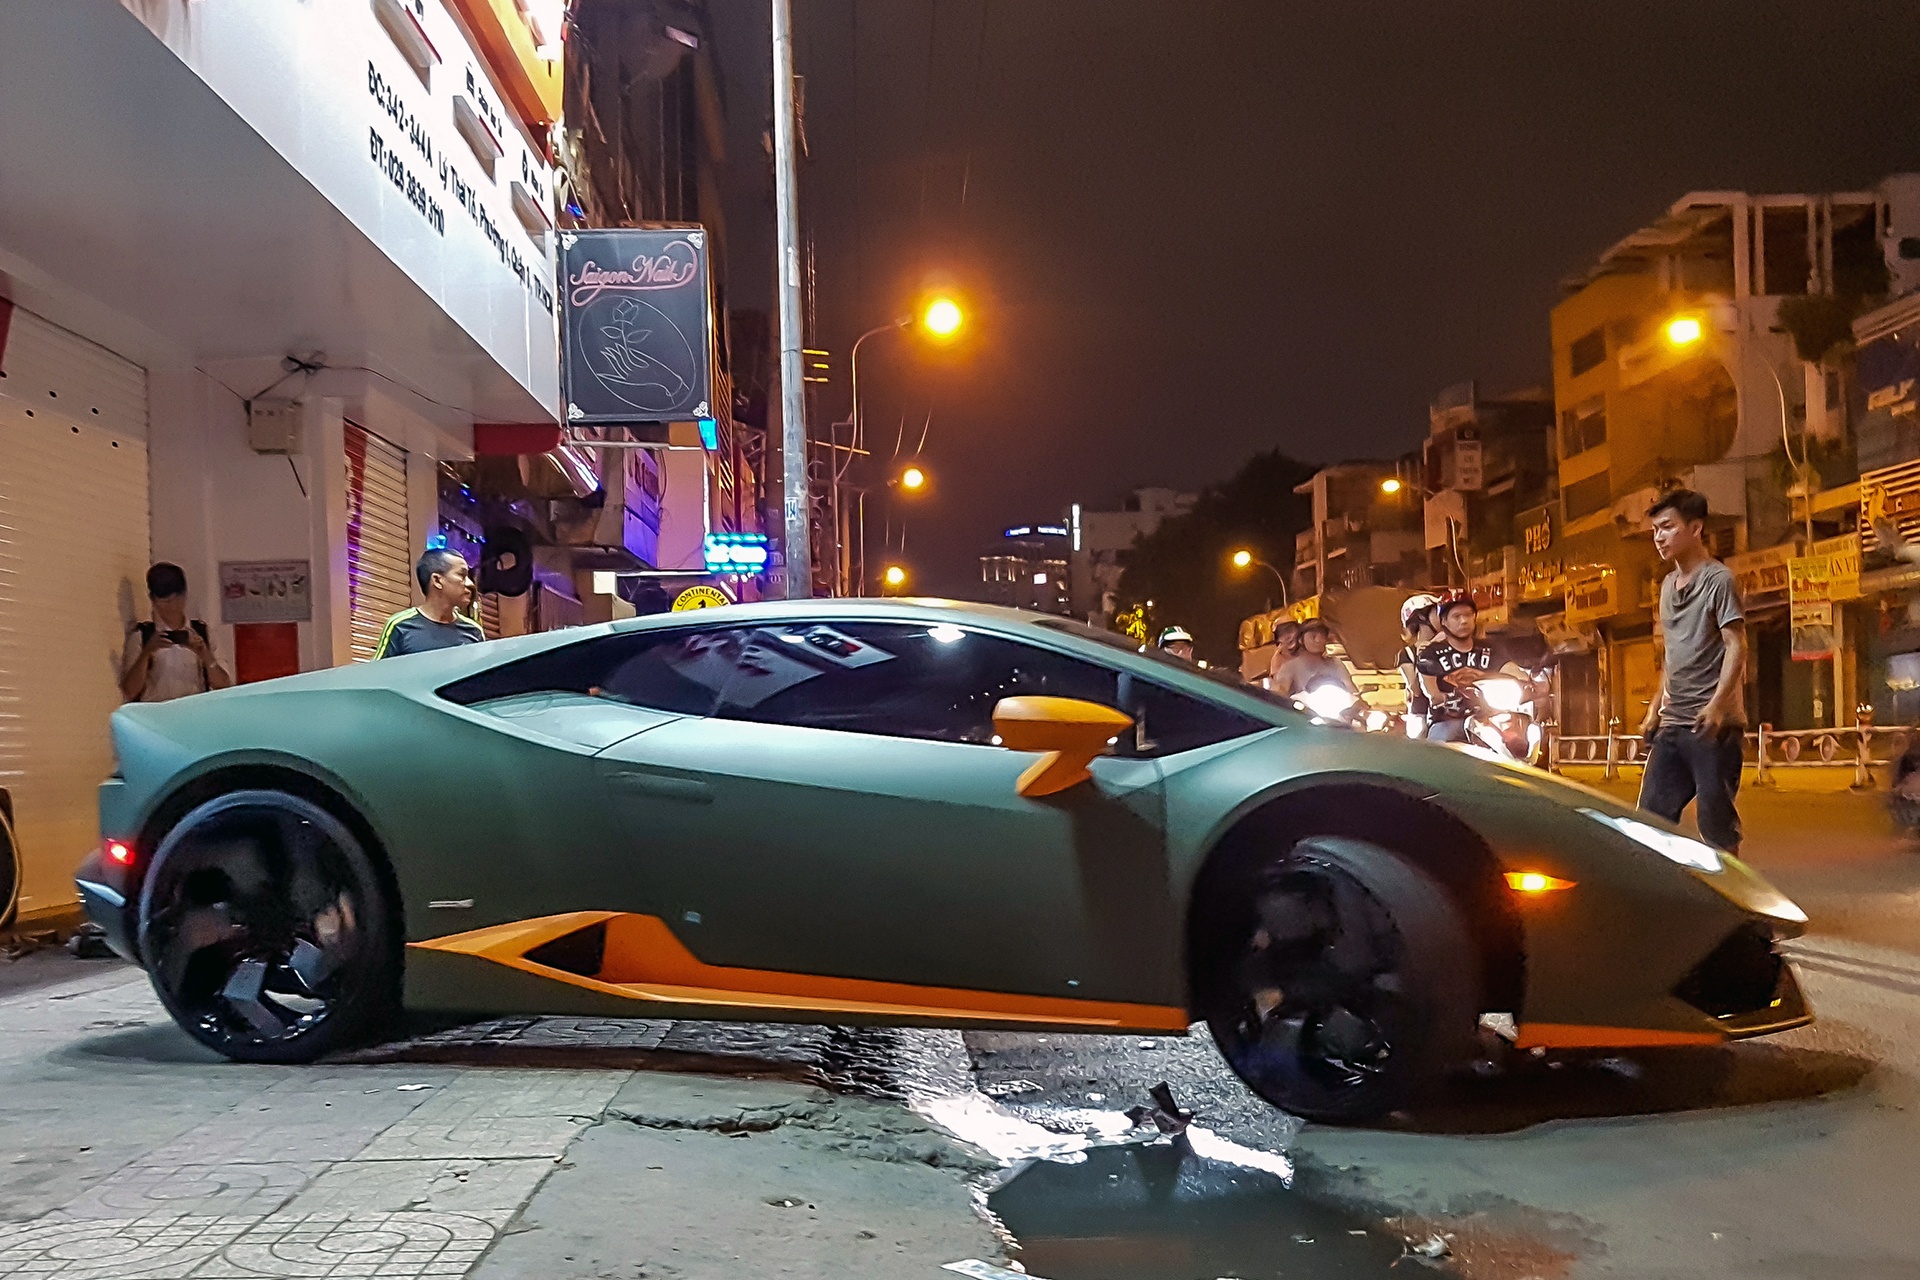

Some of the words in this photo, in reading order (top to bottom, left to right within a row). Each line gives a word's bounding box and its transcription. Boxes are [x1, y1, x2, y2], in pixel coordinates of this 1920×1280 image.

[570, 260, 634, 302] Saigon
[631, 248, 697, 285] Nails
[1438, 651, 1491, 672] ECKO
